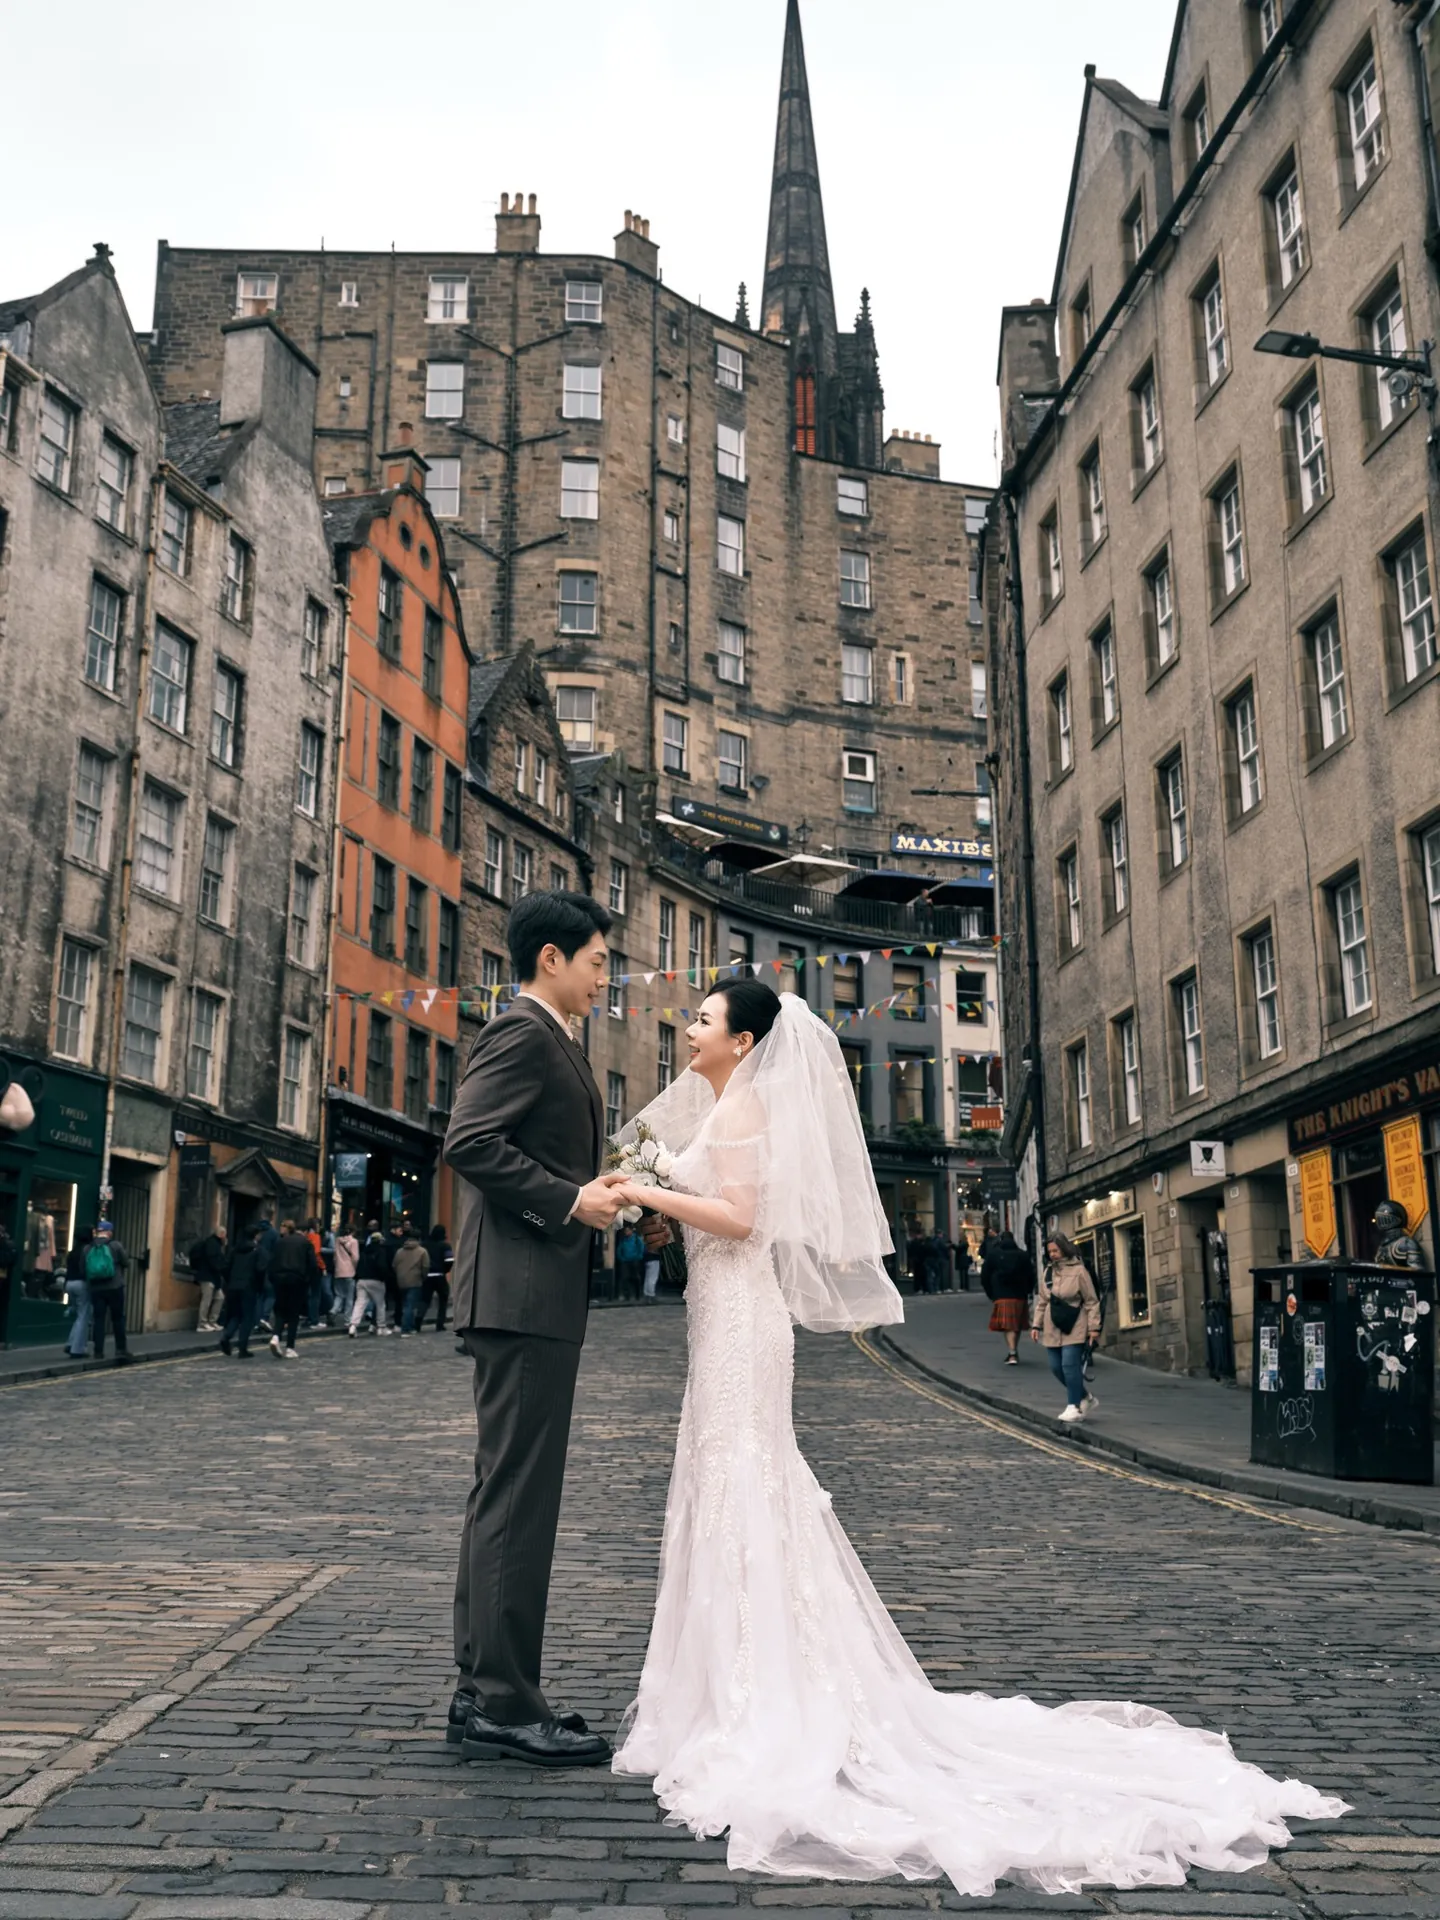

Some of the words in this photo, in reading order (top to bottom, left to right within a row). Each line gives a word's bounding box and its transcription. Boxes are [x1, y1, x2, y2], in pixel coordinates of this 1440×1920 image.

[896, 834, 994, 857] MAXIES
[1294, 1110, 1327, 1143] THE
[1329, 1077, 1411, 1130] KNIGHT'S
[1413, 1063, 1440, 1096] VA
